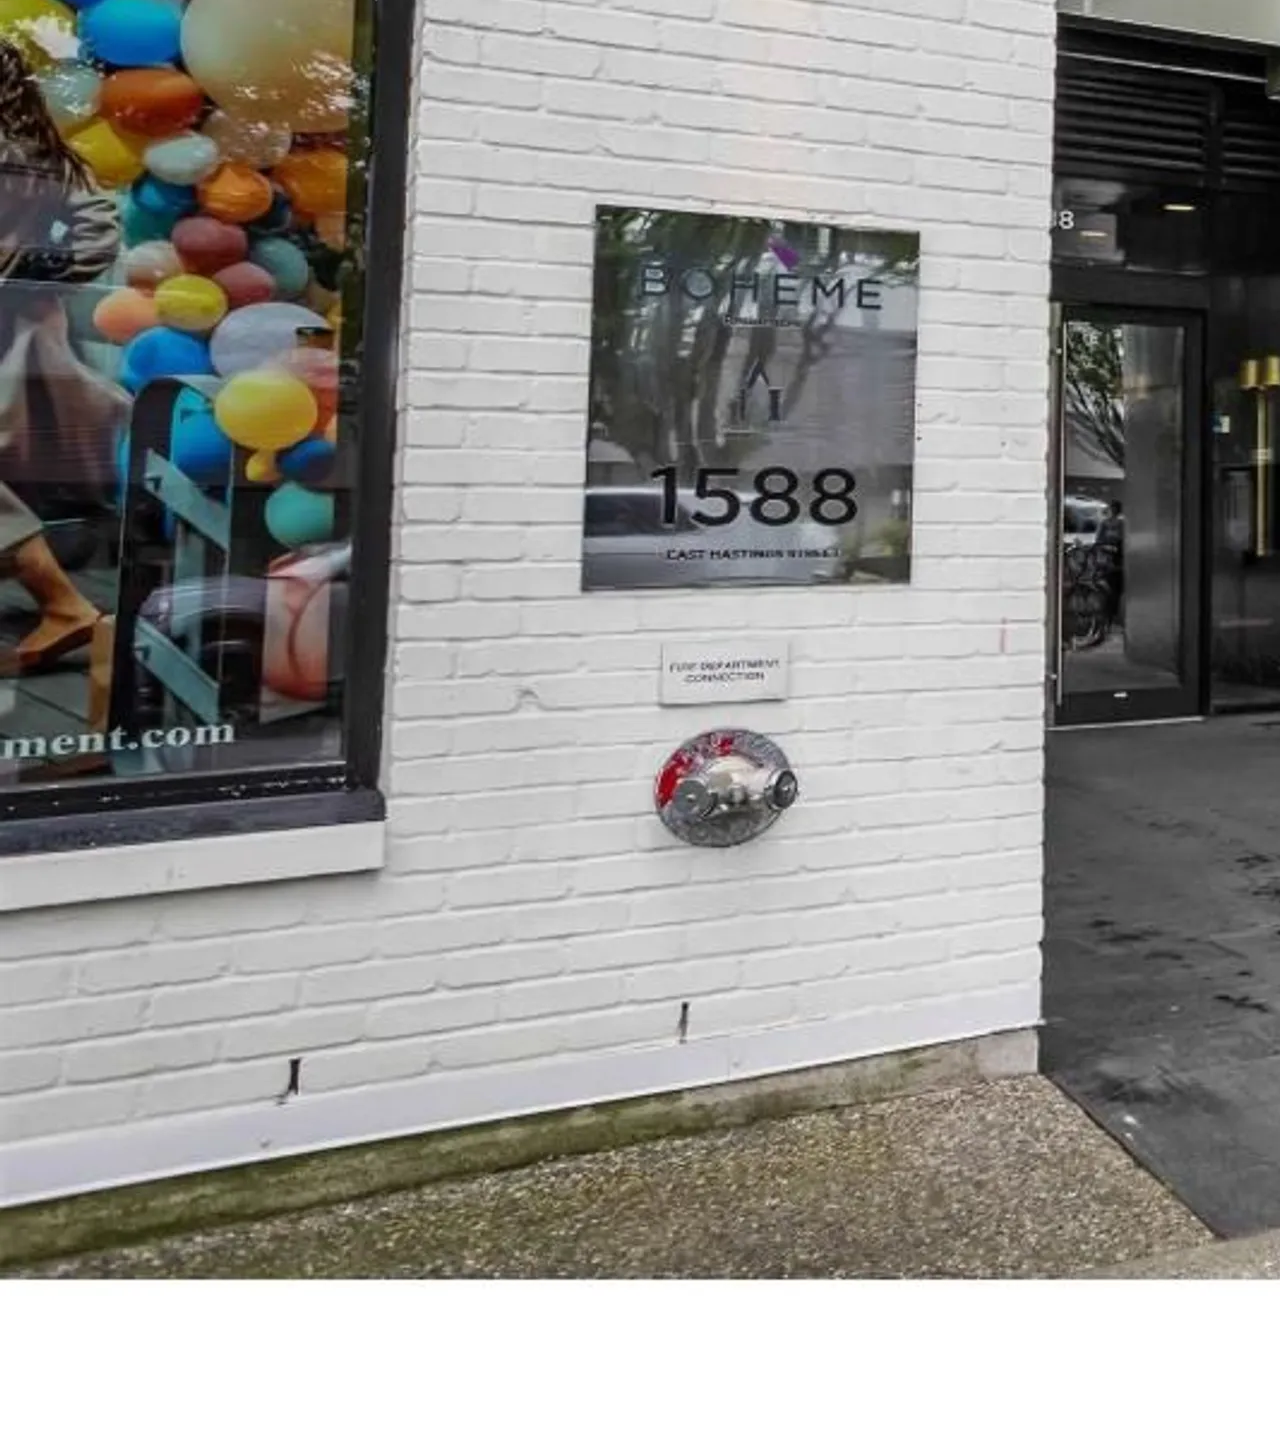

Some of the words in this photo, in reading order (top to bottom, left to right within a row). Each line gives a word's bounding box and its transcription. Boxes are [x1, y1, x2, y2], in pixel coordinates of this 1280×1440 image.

[640, 264, 882, 310] BOHEME
[650, 465, 859, 528] 1588
[1, 722, 236, 760] ment.com
